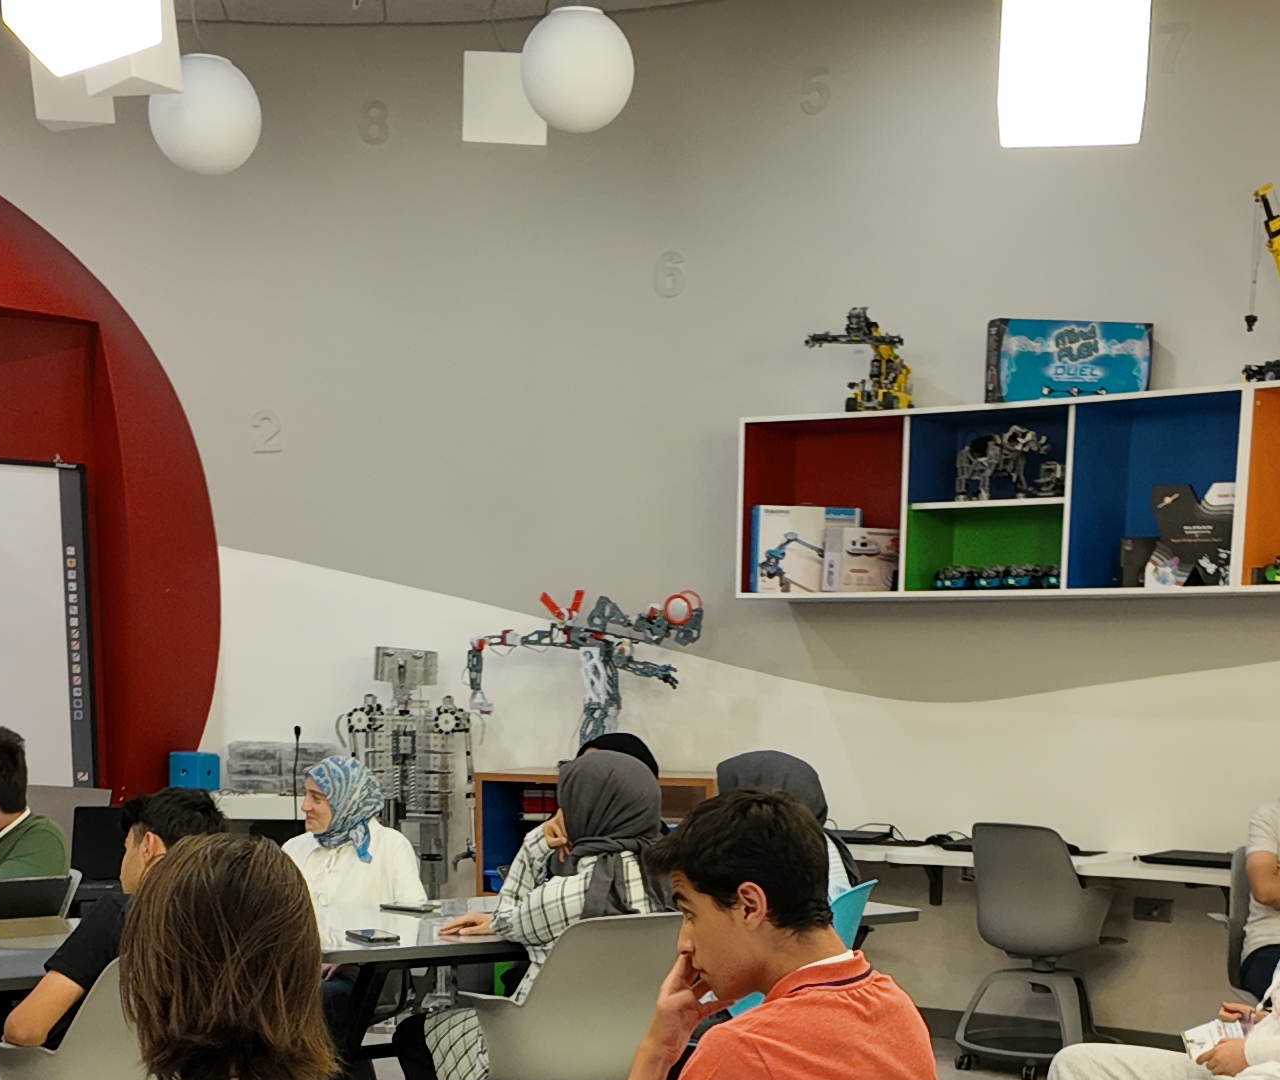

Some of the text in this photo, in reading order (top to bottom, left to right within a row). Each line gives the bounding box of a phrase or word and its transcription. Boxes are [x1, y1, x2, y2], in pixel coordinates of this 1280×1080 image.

[799, 67, 831, 116] 5
[358, 100, 390, 145] 8
[653, 250, 686, 298] 6
[1054, 364, 1100, 377] DUEL
[250, 410, 283, 454] 2
